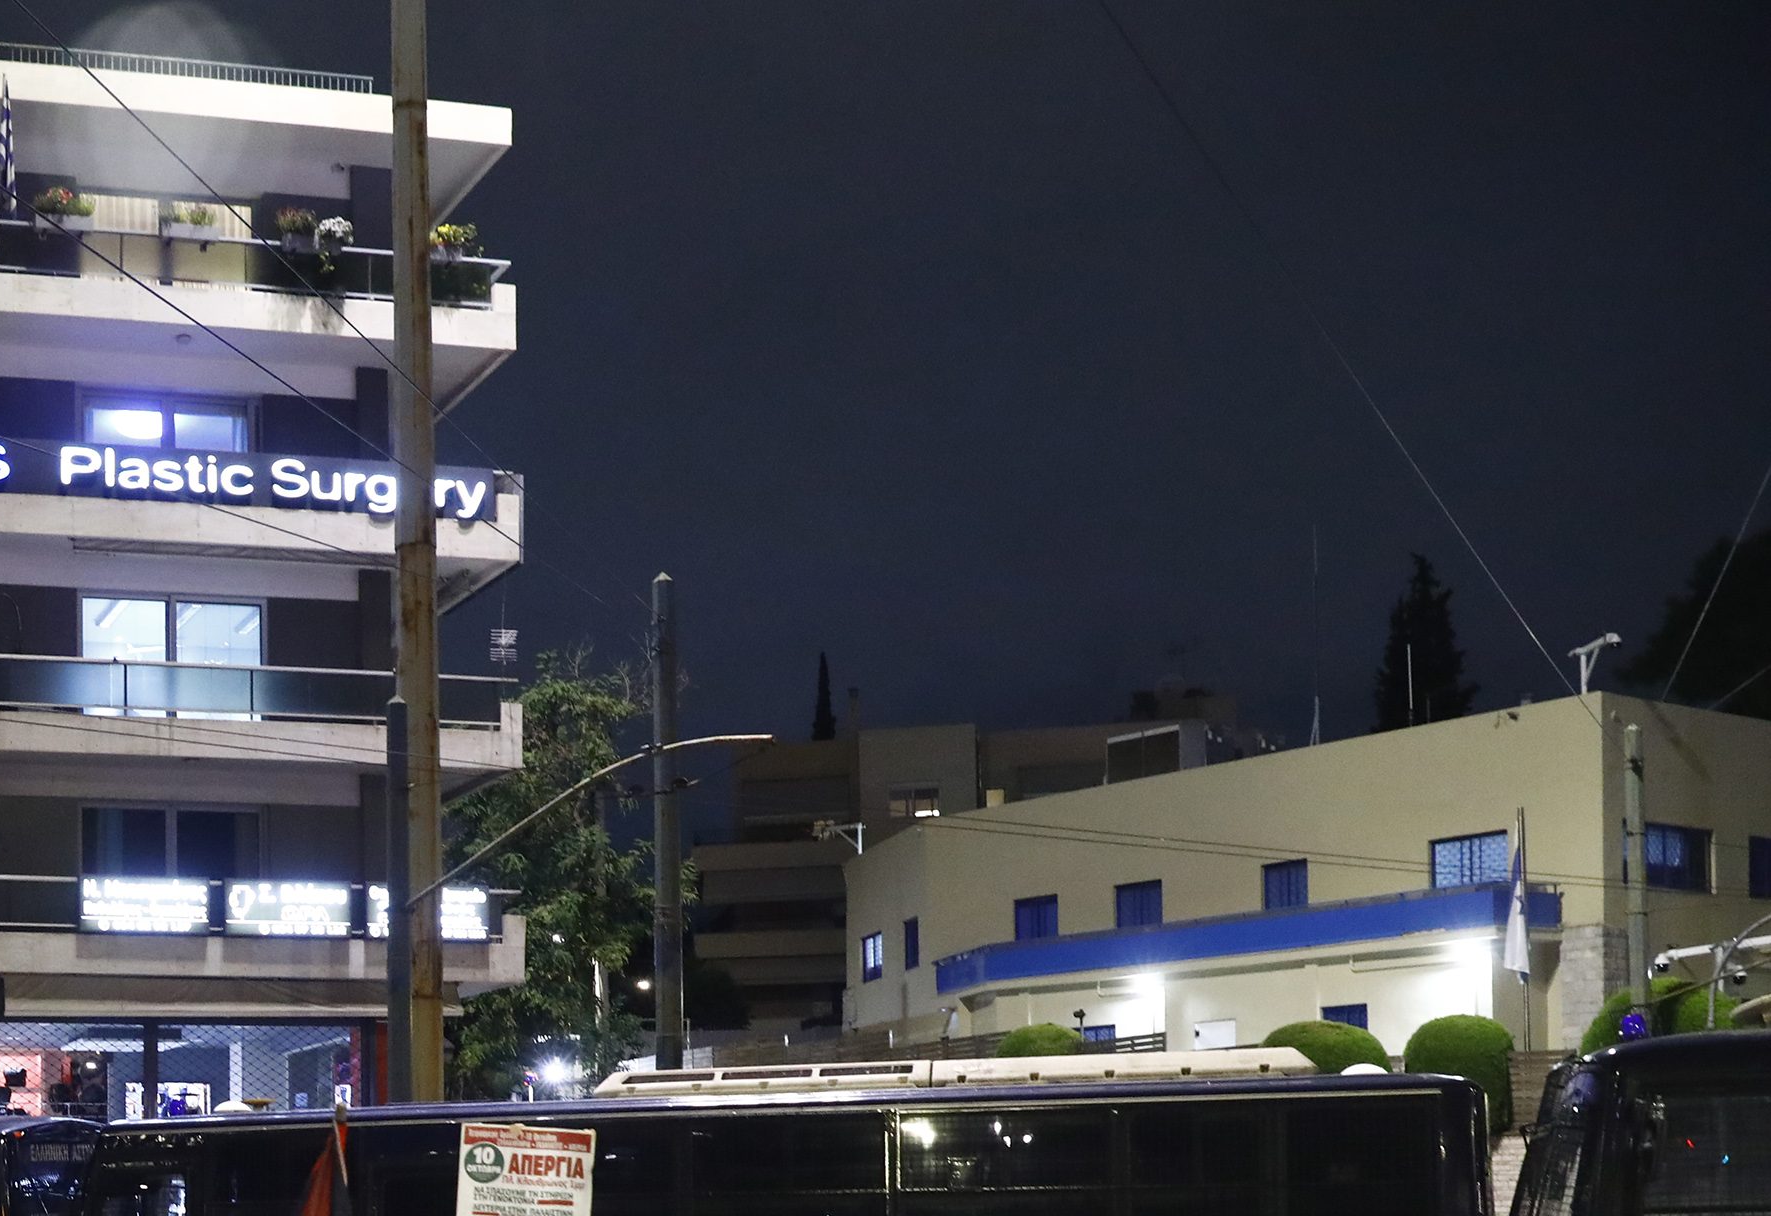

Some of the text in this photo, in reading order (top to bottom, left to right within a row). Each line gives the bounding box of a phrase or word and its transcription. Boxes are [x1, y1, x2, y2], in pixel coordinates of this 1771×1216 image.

[60, 445, 255, 496] Plastic
[272, 458, 487, 519] Surgry
[472, 1146, 496, 1165] 10
[508, 1153, 584, 1179] ΑΠΕΡΓΙΑ
